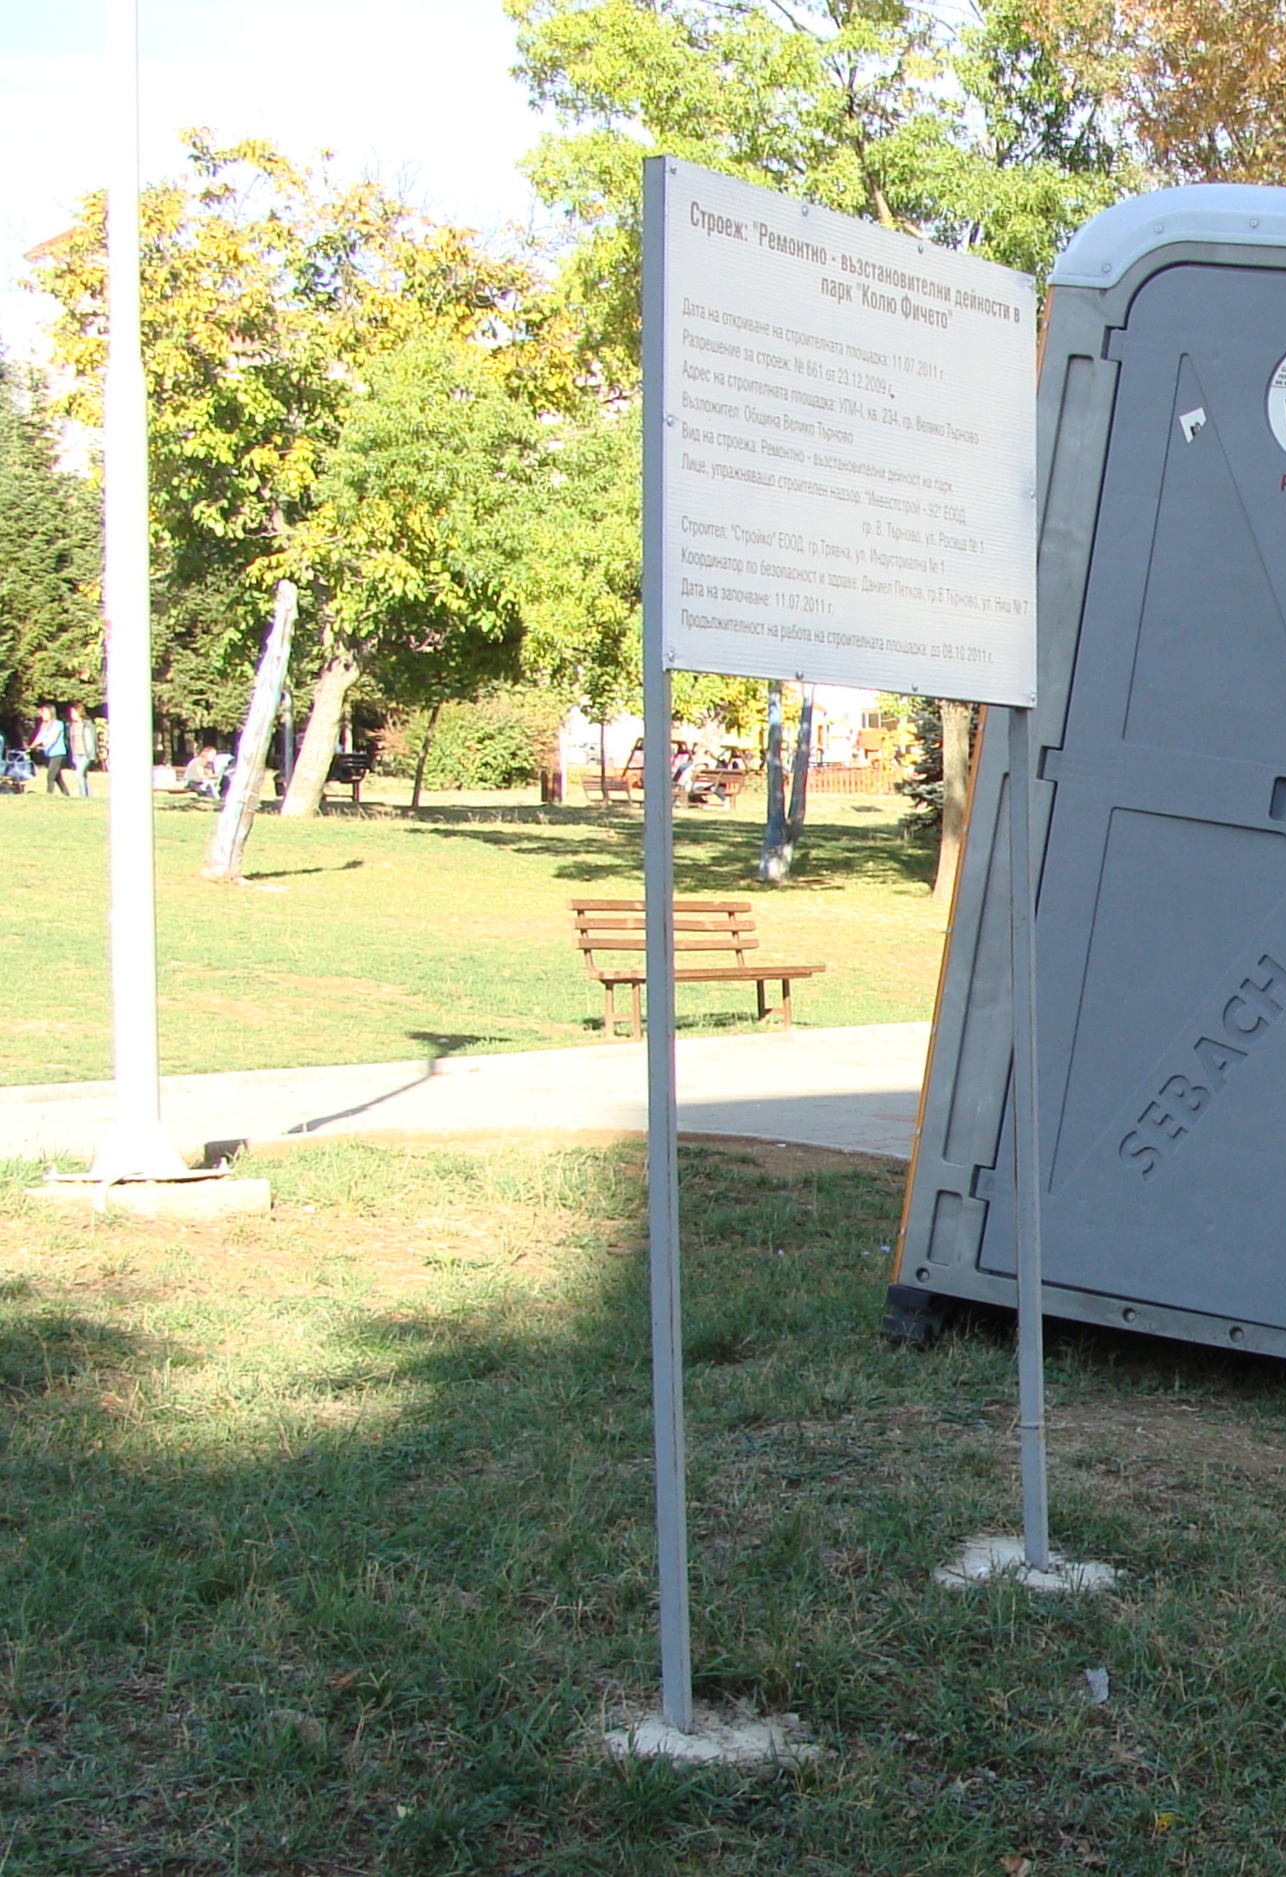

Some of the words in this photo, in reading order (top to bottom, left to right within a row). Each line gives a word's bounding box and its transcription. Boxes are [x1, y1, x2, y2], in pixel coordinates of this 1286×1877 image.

[690, 201, 747, 241] Строеж:
[753, 221, 827, 265] "Ремонтно
[954, 289, 1010, 320] дейности
[1013, 307, 1021, 324] в
[821, 277, 852, 304] парк
[857, 283, 897, 314] "Колю
[901, 295, 952, 329] Фичето"
[682, 297, 705, 319] Дата
[708, 309, 719, 323] на
[722, 312, 769, 336] откриване
[772, 326, 783, 339] на
[785, 328, 843, 355] строителната
[892, 354, 937, 379] 11.07.2011
[682, 328, 741, 359] Разрешение
[743, 348, 754, 362] за
[794, 357, 804, 374] №
[806, 360, 822, 379] 661
[825, 369, 835, 381] от
[838, 368, 886, 395] 23.12.2009
[682, 360, 711, 382] Адрес
[713, 371, 725, 385] на
[727, 374, 788, 401] строителната
[682, 421, 700, 442] Вид
[702, 430, 714, 444] на
[761, 438, 804, 463] Ремонтно
[744, 404, 781, 429] Община
[783, 413, 815, 436] Велико
[816, 421, 853, 444] Търново
[681, 452, 709, 475] Лице,
[711, 463, 775, 487] упражняващо
[778, 476, 828, 497] строителен
[681, 515, 727, 538] Строител:
[731, 524, 776, 546] "Стройко"
[681, 547, 743, 575] Координатор
[746, 560, 757, 575] по
[760, 559, 817, 583] безопасност
[819, 573, 825, 584] и
[681, 577, 704, 597] Дата
[707, 586, 718, 599] на
[721, 587, 769, 606] започване:
[775, 592, 824, 613] 11.07.2011
[681, 608, 765, 635] Продължителност
[767, 624, 778, 637] на
[780, 624, 812, 642] работа
[814, 630, 825, 643] на
[826, 631, 884, 651] строителната
